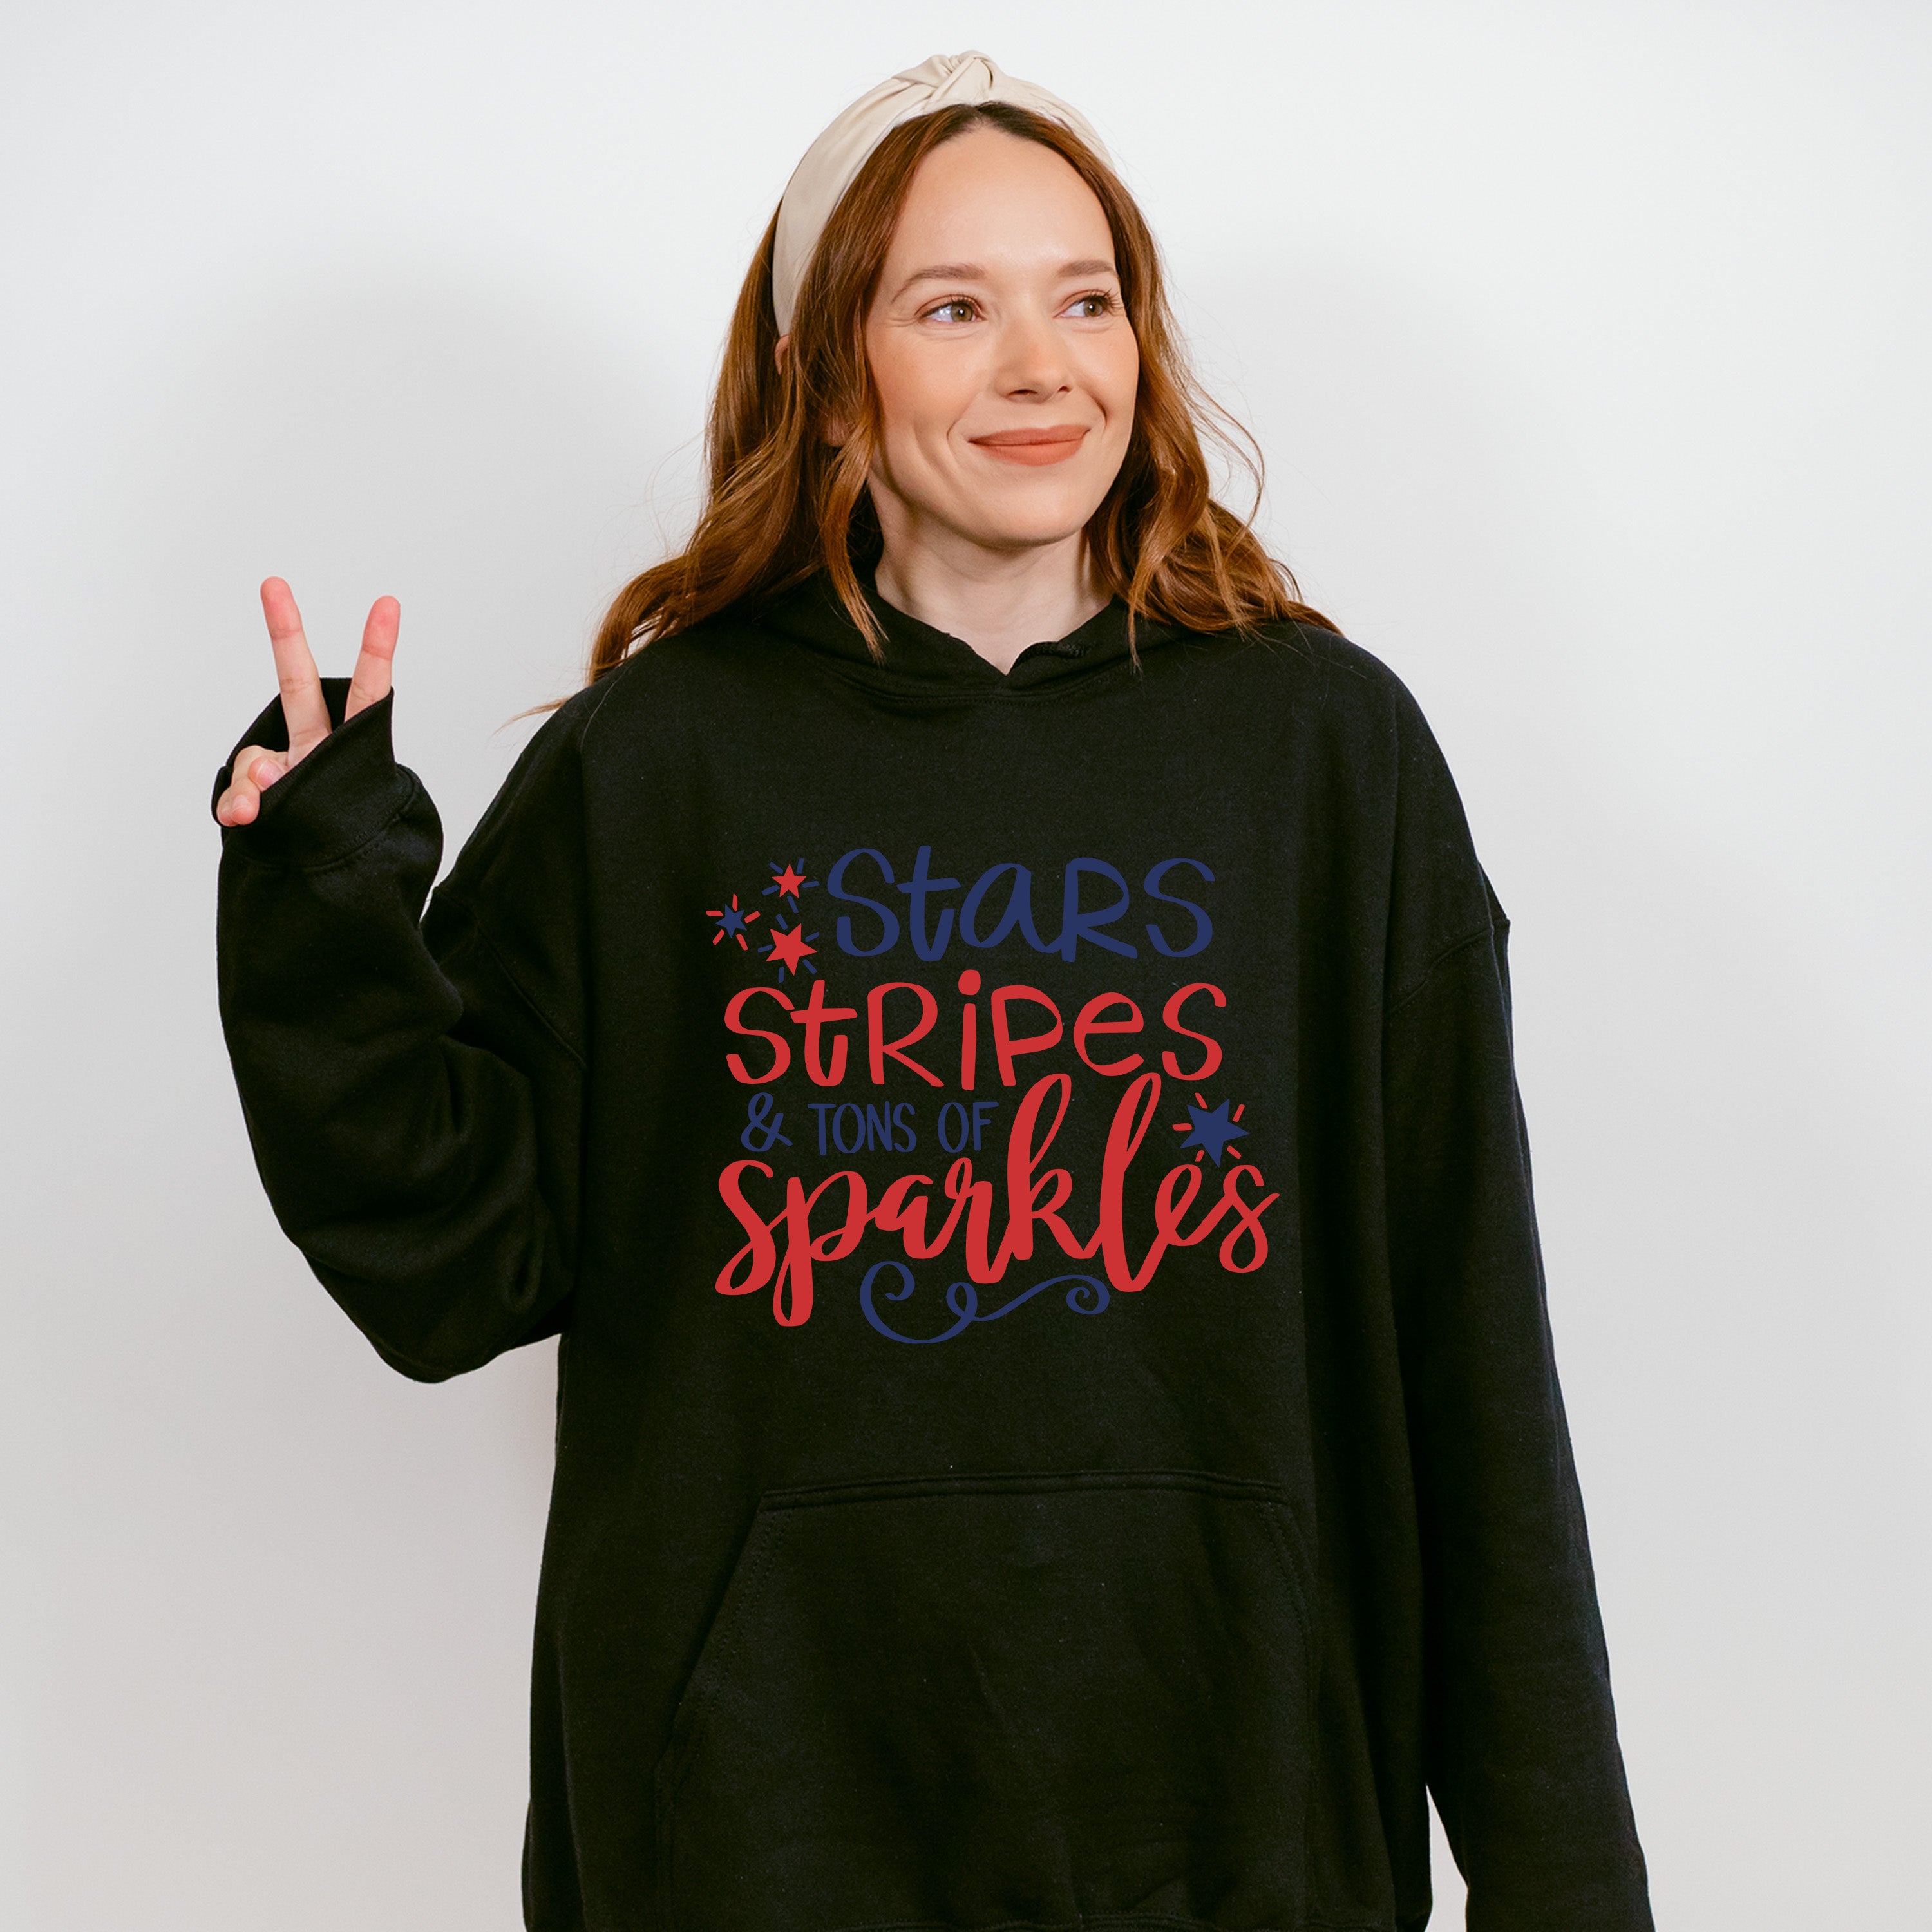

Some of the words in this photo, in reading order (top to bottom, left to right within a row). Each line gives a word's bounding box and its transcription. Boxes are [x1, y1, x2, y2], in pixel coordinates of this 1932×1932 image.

[740, 1092, 793, 1152] &
[808, 1101, 917, 1156] TONS
[937, 1101, 999, 1153] OF
